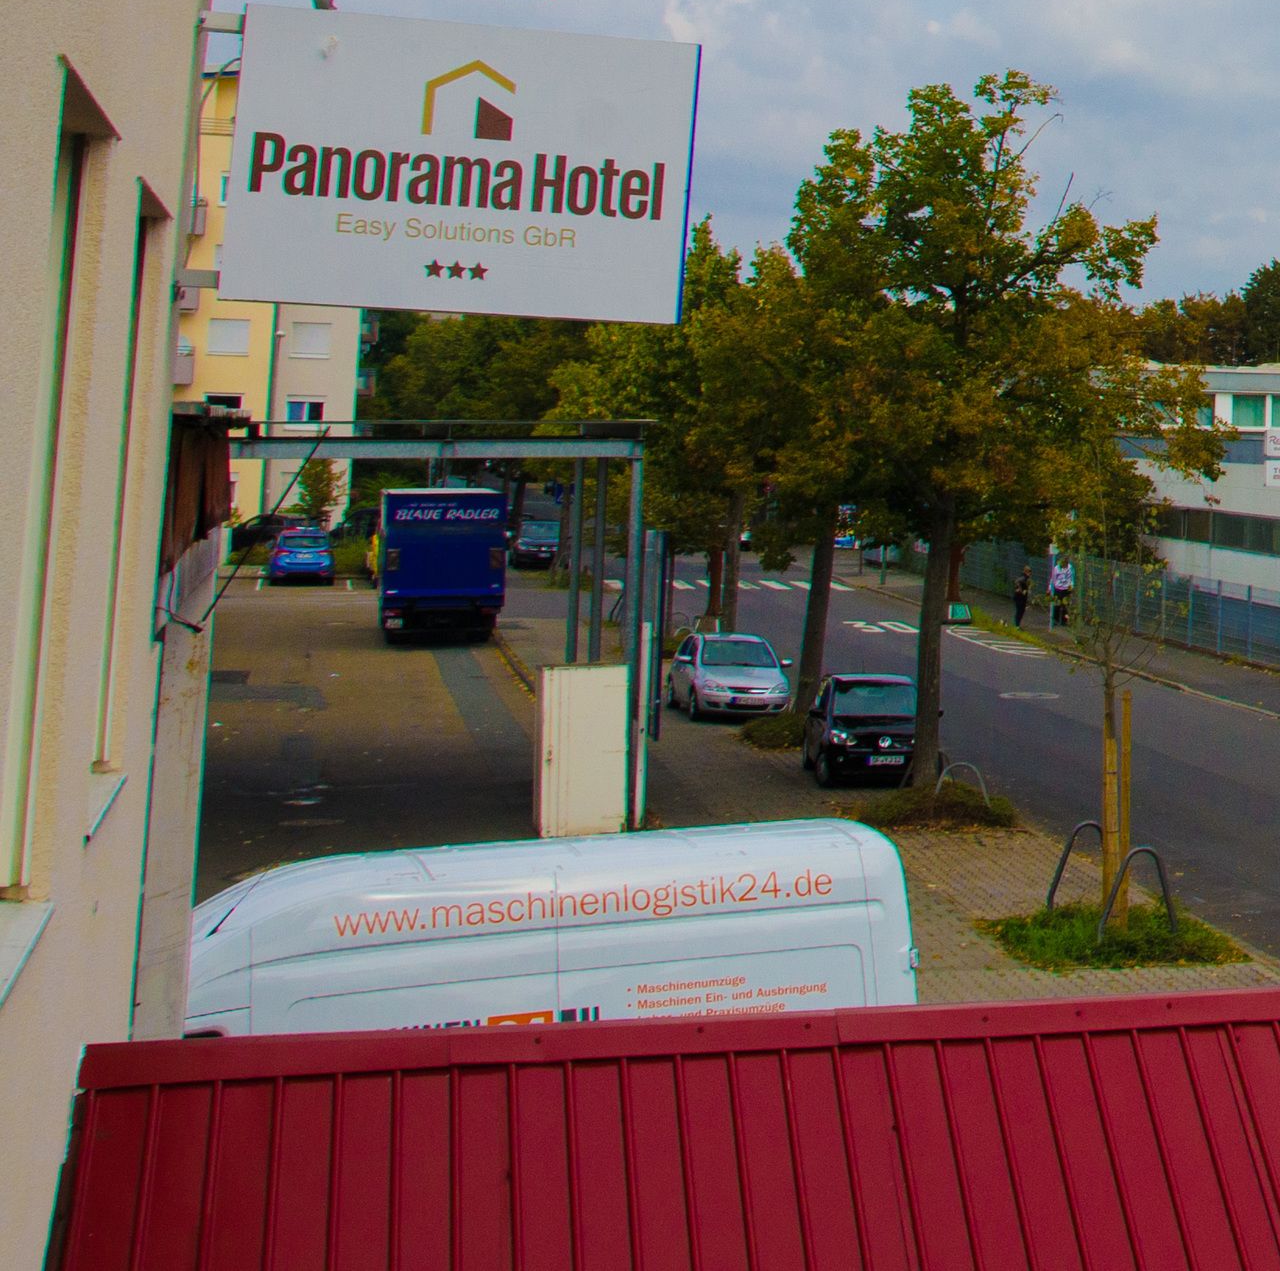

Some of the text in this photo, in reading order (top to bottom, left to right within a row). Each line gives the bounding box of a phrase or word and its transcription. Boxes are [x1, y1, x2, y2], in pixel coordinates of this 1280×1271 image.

[248, 131, 666, 221] Panorama Hotel
[335, 212, 577, 248] Easy Solutions GbR
[395, 507, 500, 520] BLAUE RADLER
[843, 620, 920, 633] 30
[334, 870, 833, 937] www.maschinenlogistik24.de
[637, 975, 746, 994] Maschinenumzüge
[637, 982, 827, 1010] Maschinen Ein- und Ausbringung
